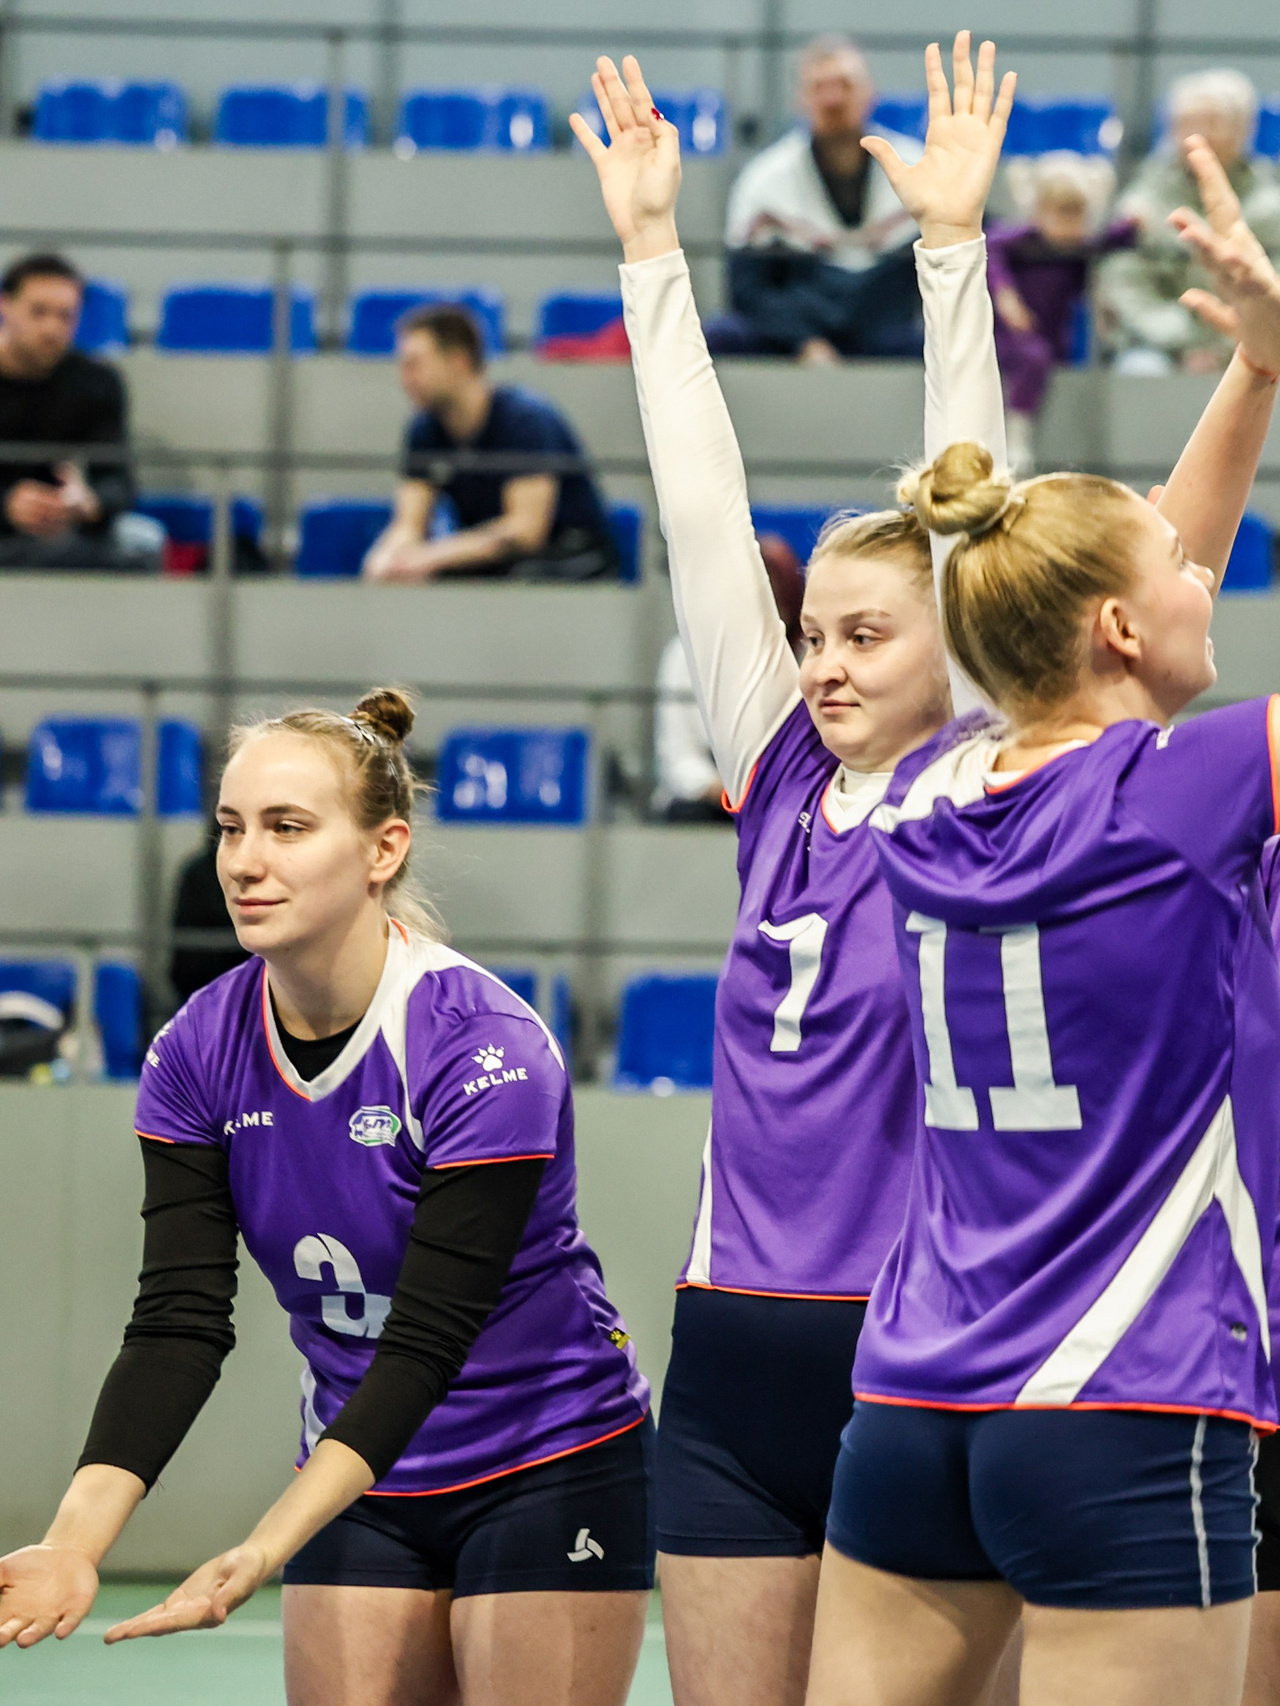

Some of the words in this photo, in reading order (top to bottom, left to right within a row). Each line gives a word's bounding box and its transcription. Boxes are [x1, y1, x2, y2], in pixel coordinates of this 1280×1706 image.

[905, 910, 1083, 1132] 11
[462, 1067, 529, 1096] KELME
[223, 1111, 274, 1136] KME
[293, 1232, 393, 1340] 3
